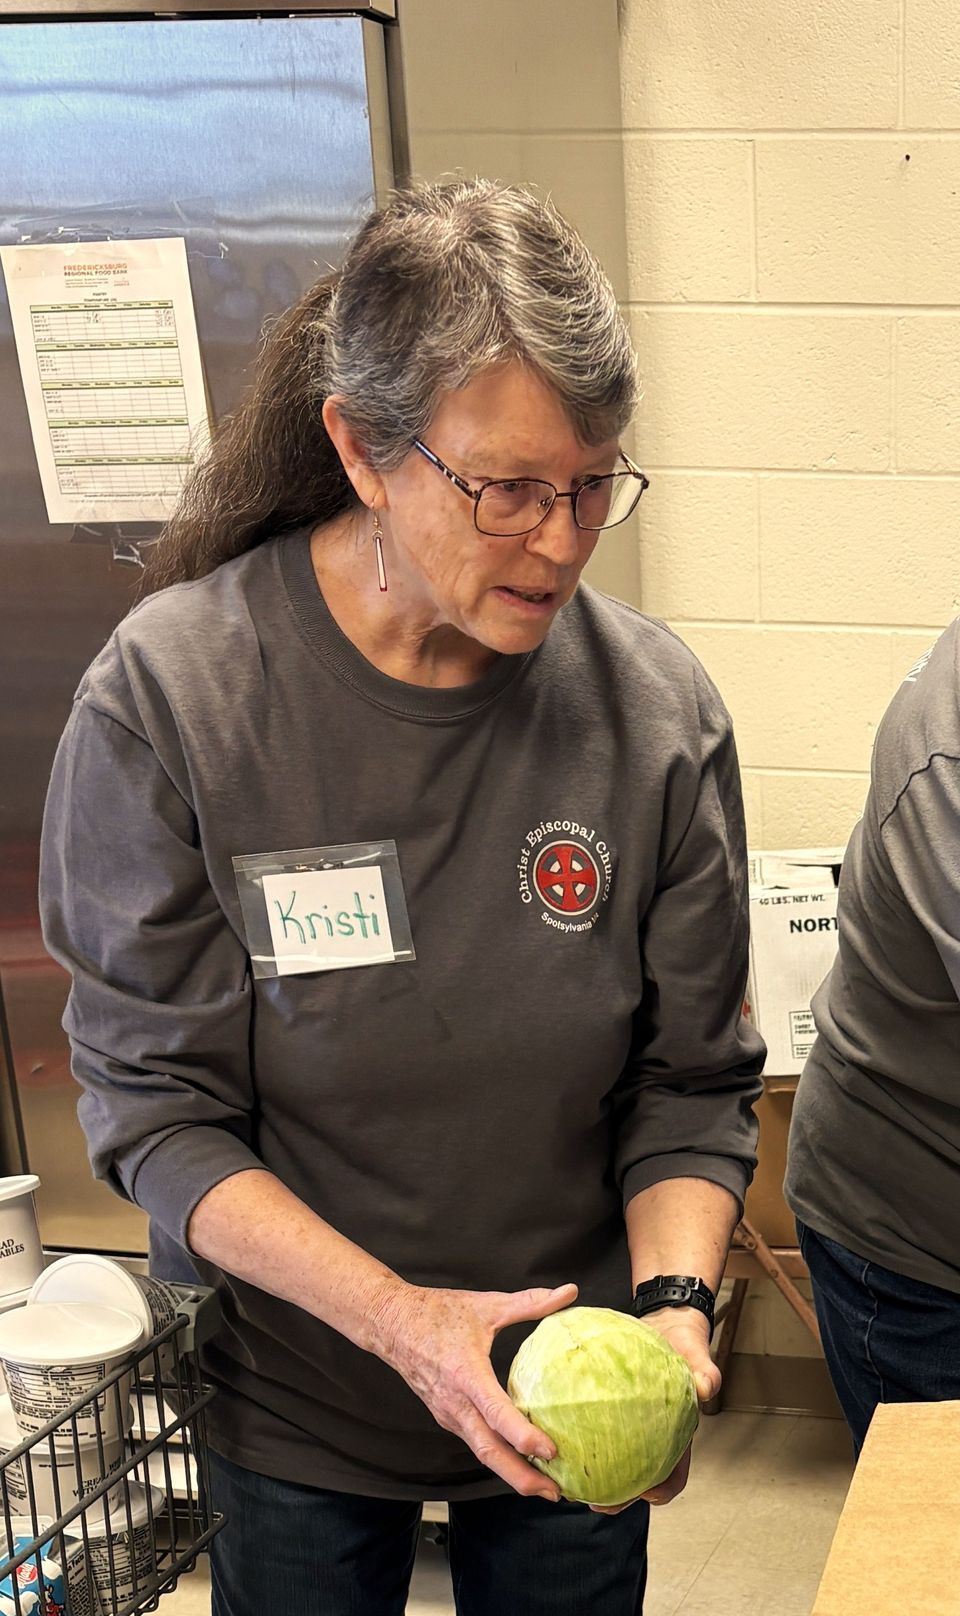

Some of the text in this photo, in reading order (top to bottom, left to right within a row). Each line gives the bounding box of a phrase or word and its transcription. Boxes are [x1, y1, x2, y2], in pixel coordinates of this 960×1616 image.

[64, 263, 127, 271] FREDERICKSBURG
[517, 820, 612, 903] Christ Episcopal Church
[792, 895, 809, 903] NET
[274, 890, 381, 945] Kristi
[541, 911, 592, 933] Spotsylvania
[790, 917, 838, 933] NORT
